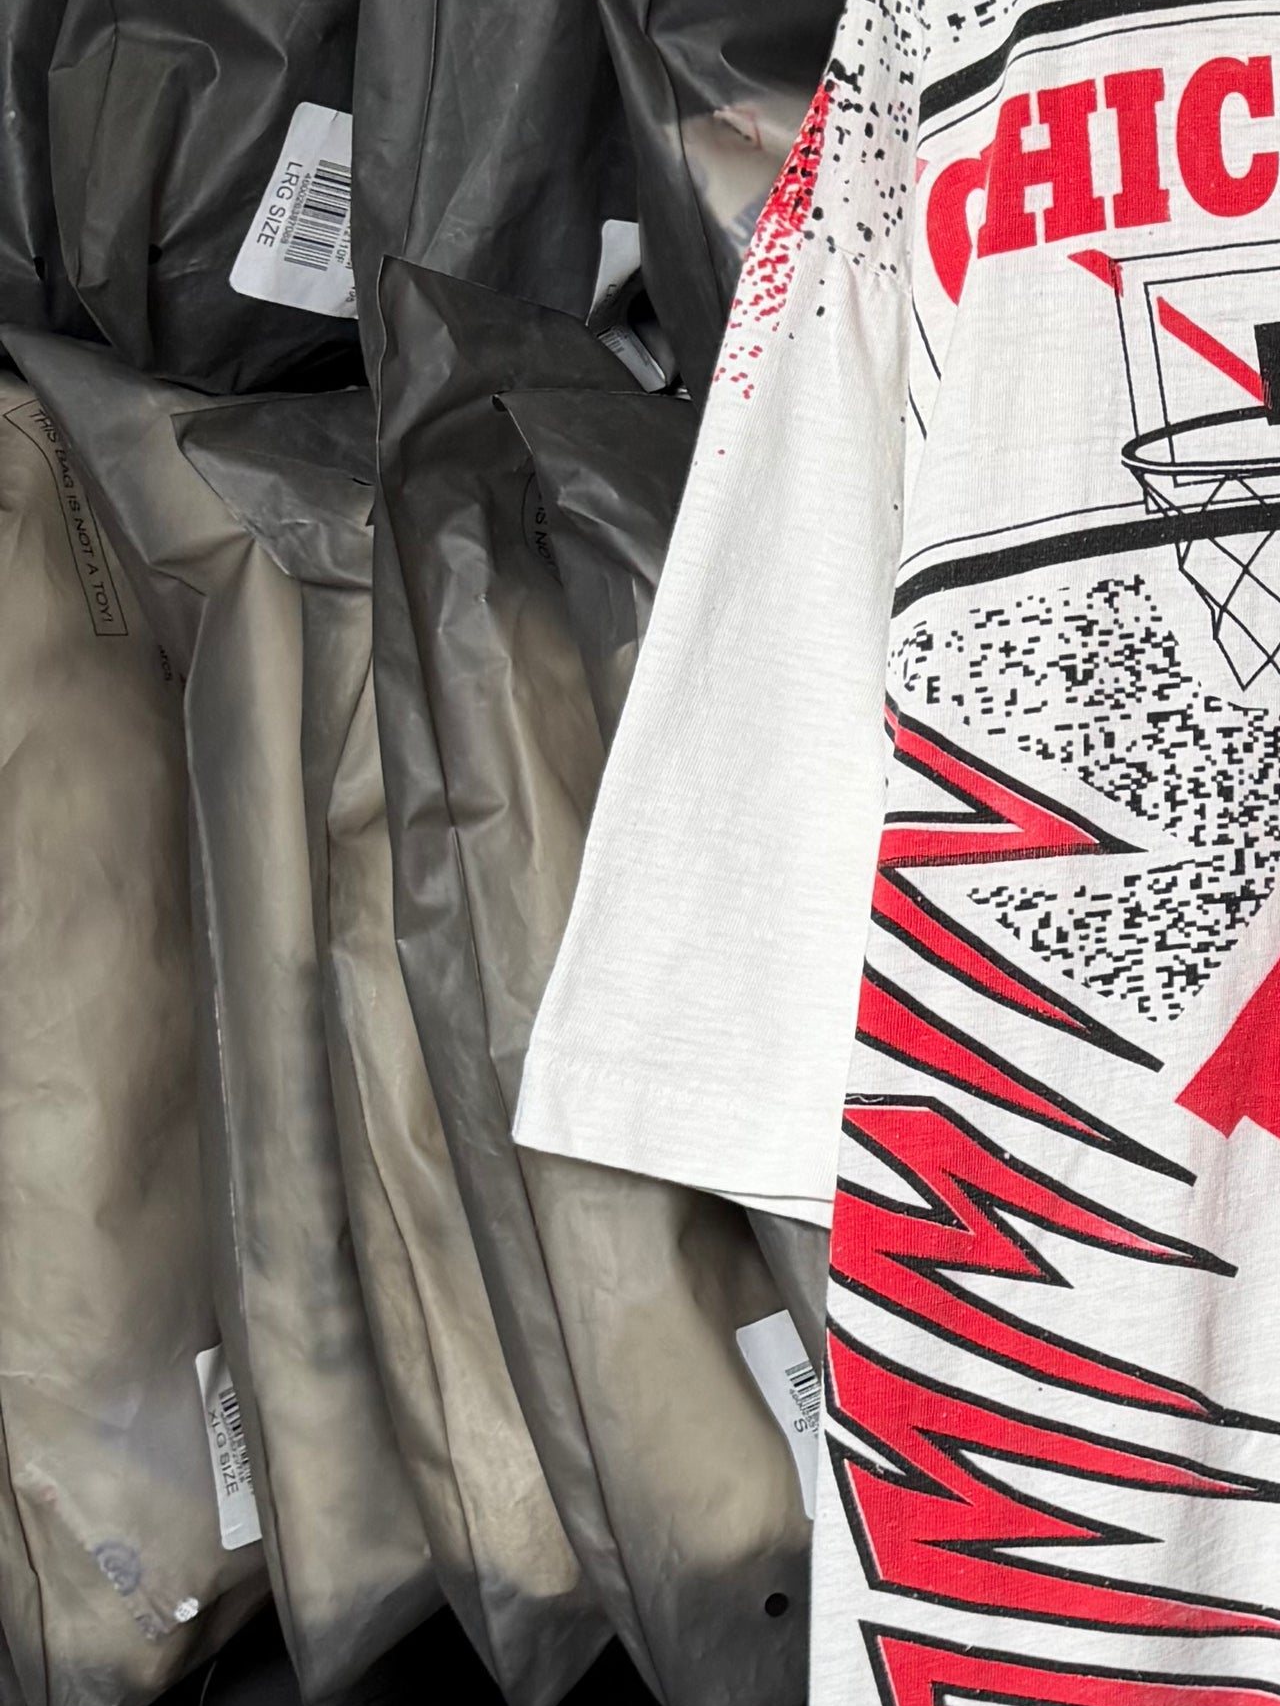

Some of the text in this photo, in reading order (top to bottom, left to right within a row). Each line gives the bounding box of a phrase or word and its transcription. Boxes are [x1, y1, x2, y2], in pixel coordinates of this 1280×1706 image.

[255, 160, 305, 249] LRG SIZE
[30, 408, 59, 444] THIS
[66, 492, 82, 513] IS
[75, 517, 98, 558] NOT
[87, 559, 102, 577] A
[207, 1409, 229, 1449] XLG
[219, 1452, 240, 1497] SIZE
[793, 1416, 810, 1435] S
